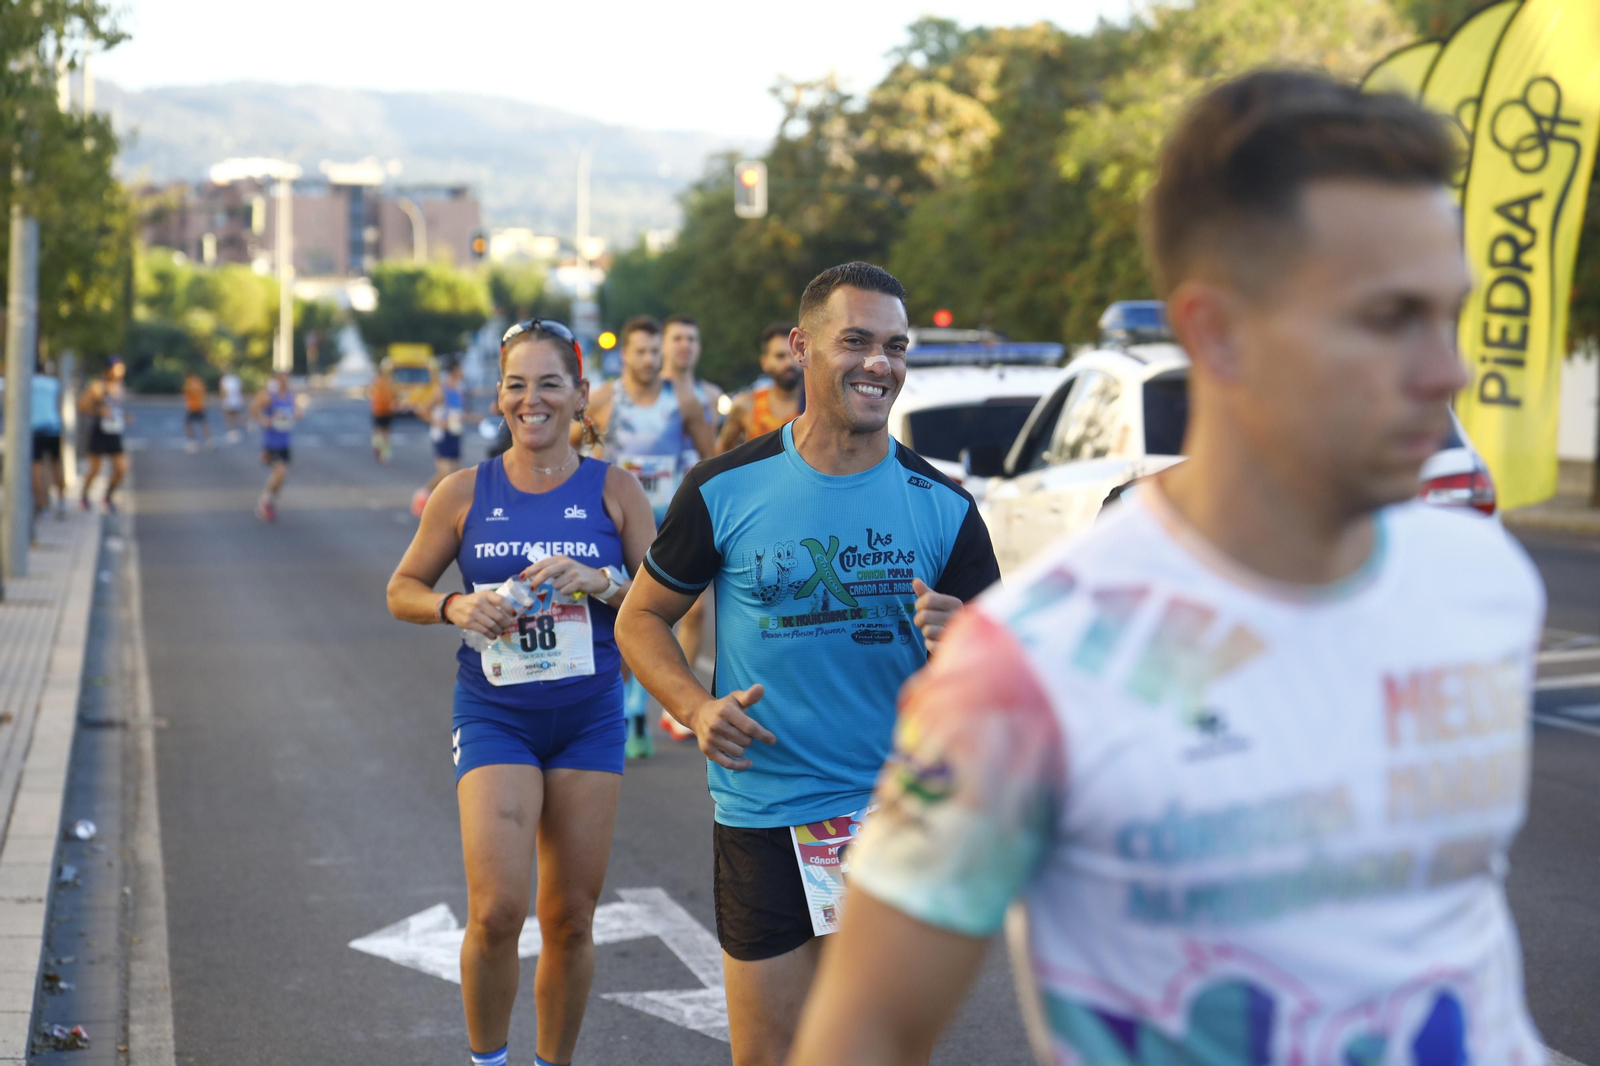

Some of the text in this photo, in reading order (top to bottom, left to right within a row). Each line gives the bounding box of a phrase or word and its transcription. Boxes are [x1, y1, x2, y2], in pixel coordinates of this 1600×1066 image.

[866, 528, 892, 551] LAS
[839, 544, 915, 573] CULEBRAS
[518, 615, 556, 652] 58
